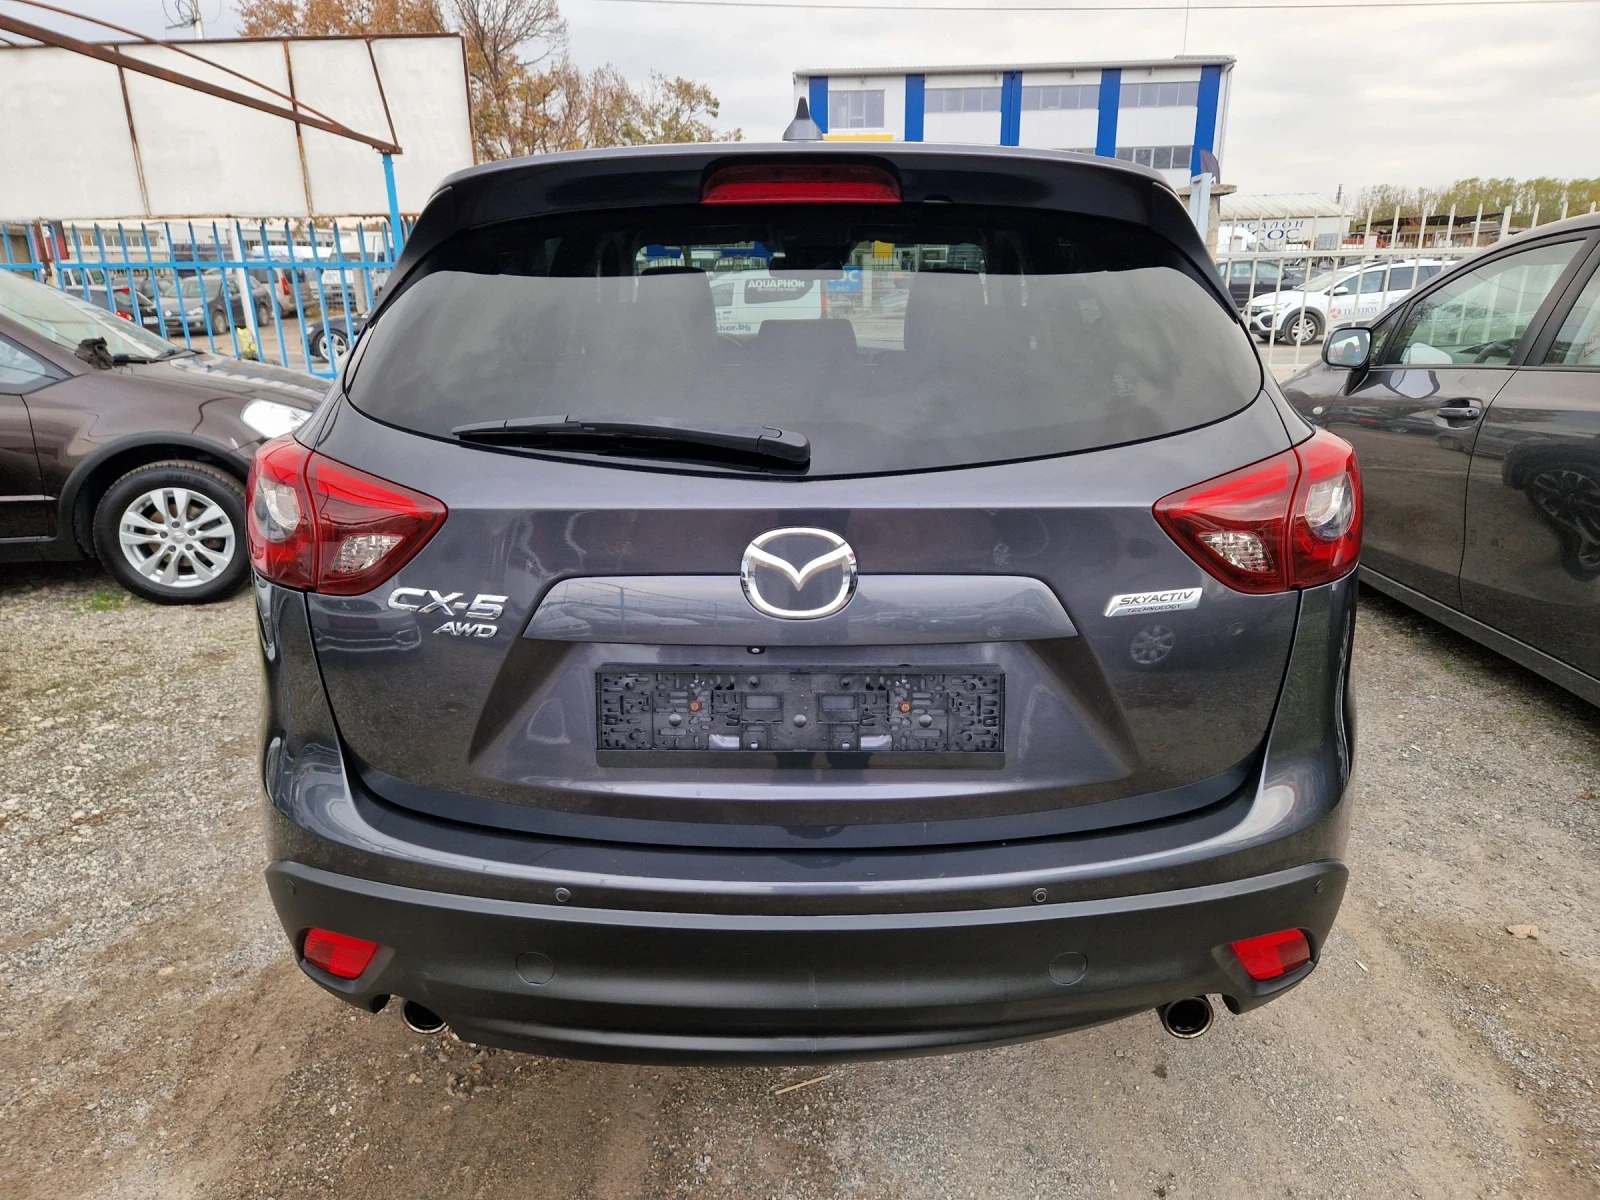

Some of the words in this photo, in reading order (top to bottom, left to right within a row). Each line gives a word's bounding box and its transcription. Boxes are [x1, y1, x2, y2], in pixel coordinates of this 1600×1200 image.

[388, 587, 508, 620] CX-5
[1119, 591, 1194, 606] SKYACTIV
[1126, 603, 1183, 613] TECHNOLOGY
[433, 621, 498, 638] AWD
